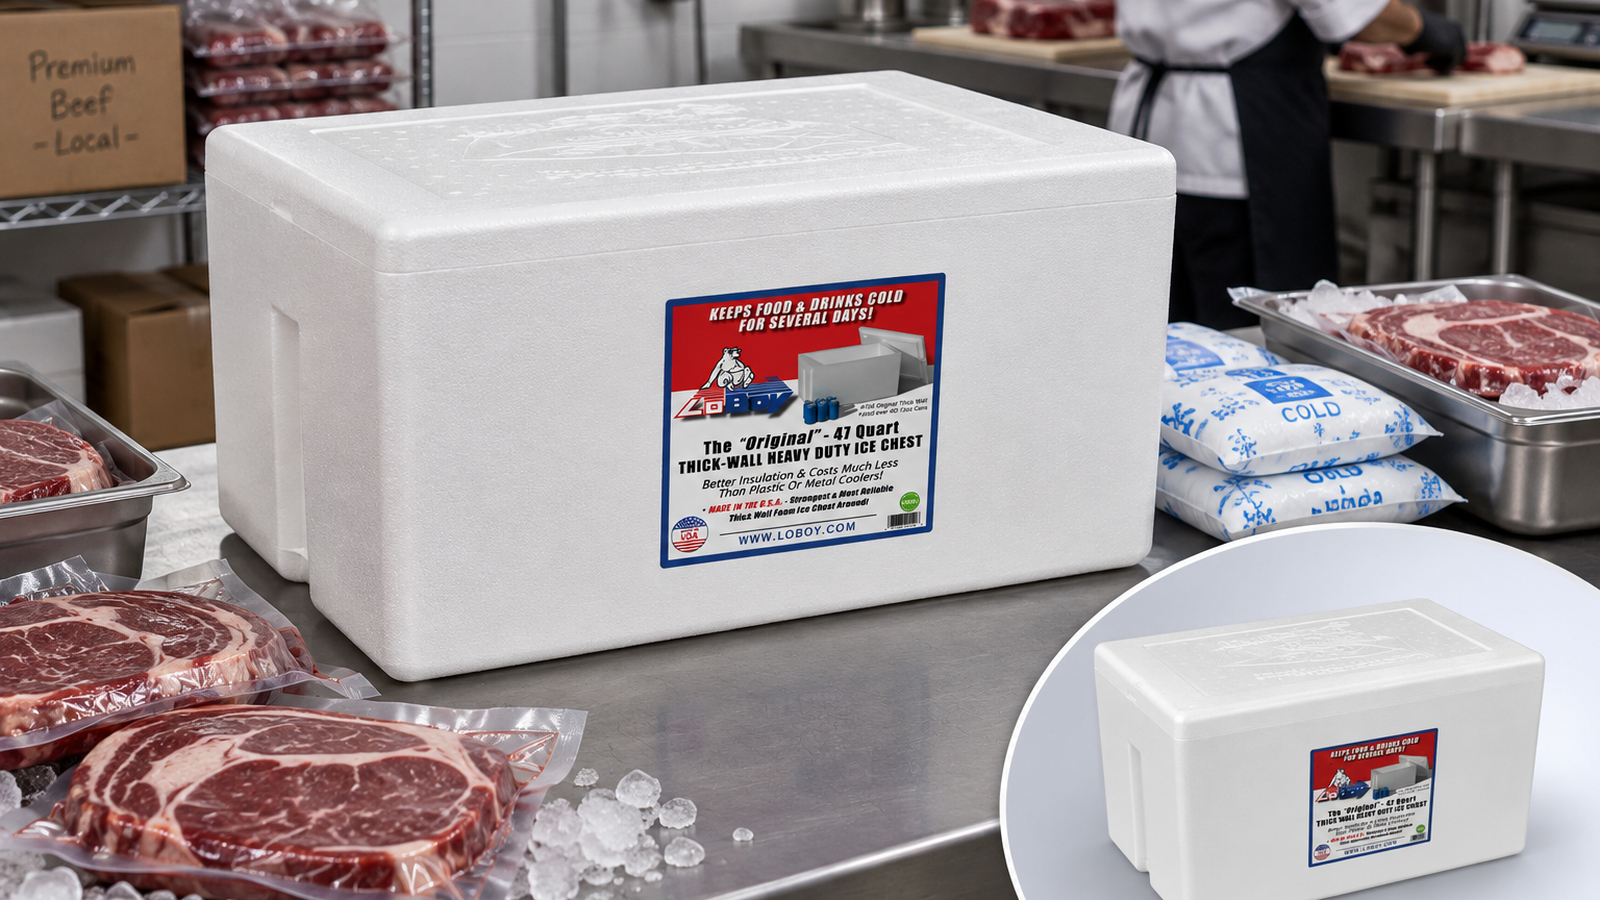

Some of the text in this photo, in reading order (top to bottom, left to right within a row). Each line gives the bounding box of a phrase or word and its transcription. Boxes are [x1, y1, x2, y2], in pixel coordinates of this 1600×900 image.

[28, 49, 137, 84] Premium
[50, 84, 115, 122] Beef
[55, 122, 120, 157] Local
[709, 289, 904, 321] KEEPS FOOD & DRINKS COLD
[738, 307, 874, 332] FOR SEVERAL DAYS!
[1281, 401, 1341, 423] COLD
[704, 440, 732, 455] The
[833, 426, 851, 440] 47
[855, 421, 899, 439] Quart
[678, 435, 923, 474] THICK-WALL HEAVY DUTY ICE CHEST
[702, 460, 899, 490] Better Insulation & Costs Much Less
[719, 471, 884, 498] Than Plastic Or Metal Coolers!
[738, 521, 856, 545] WWW.LOBOY.COM
